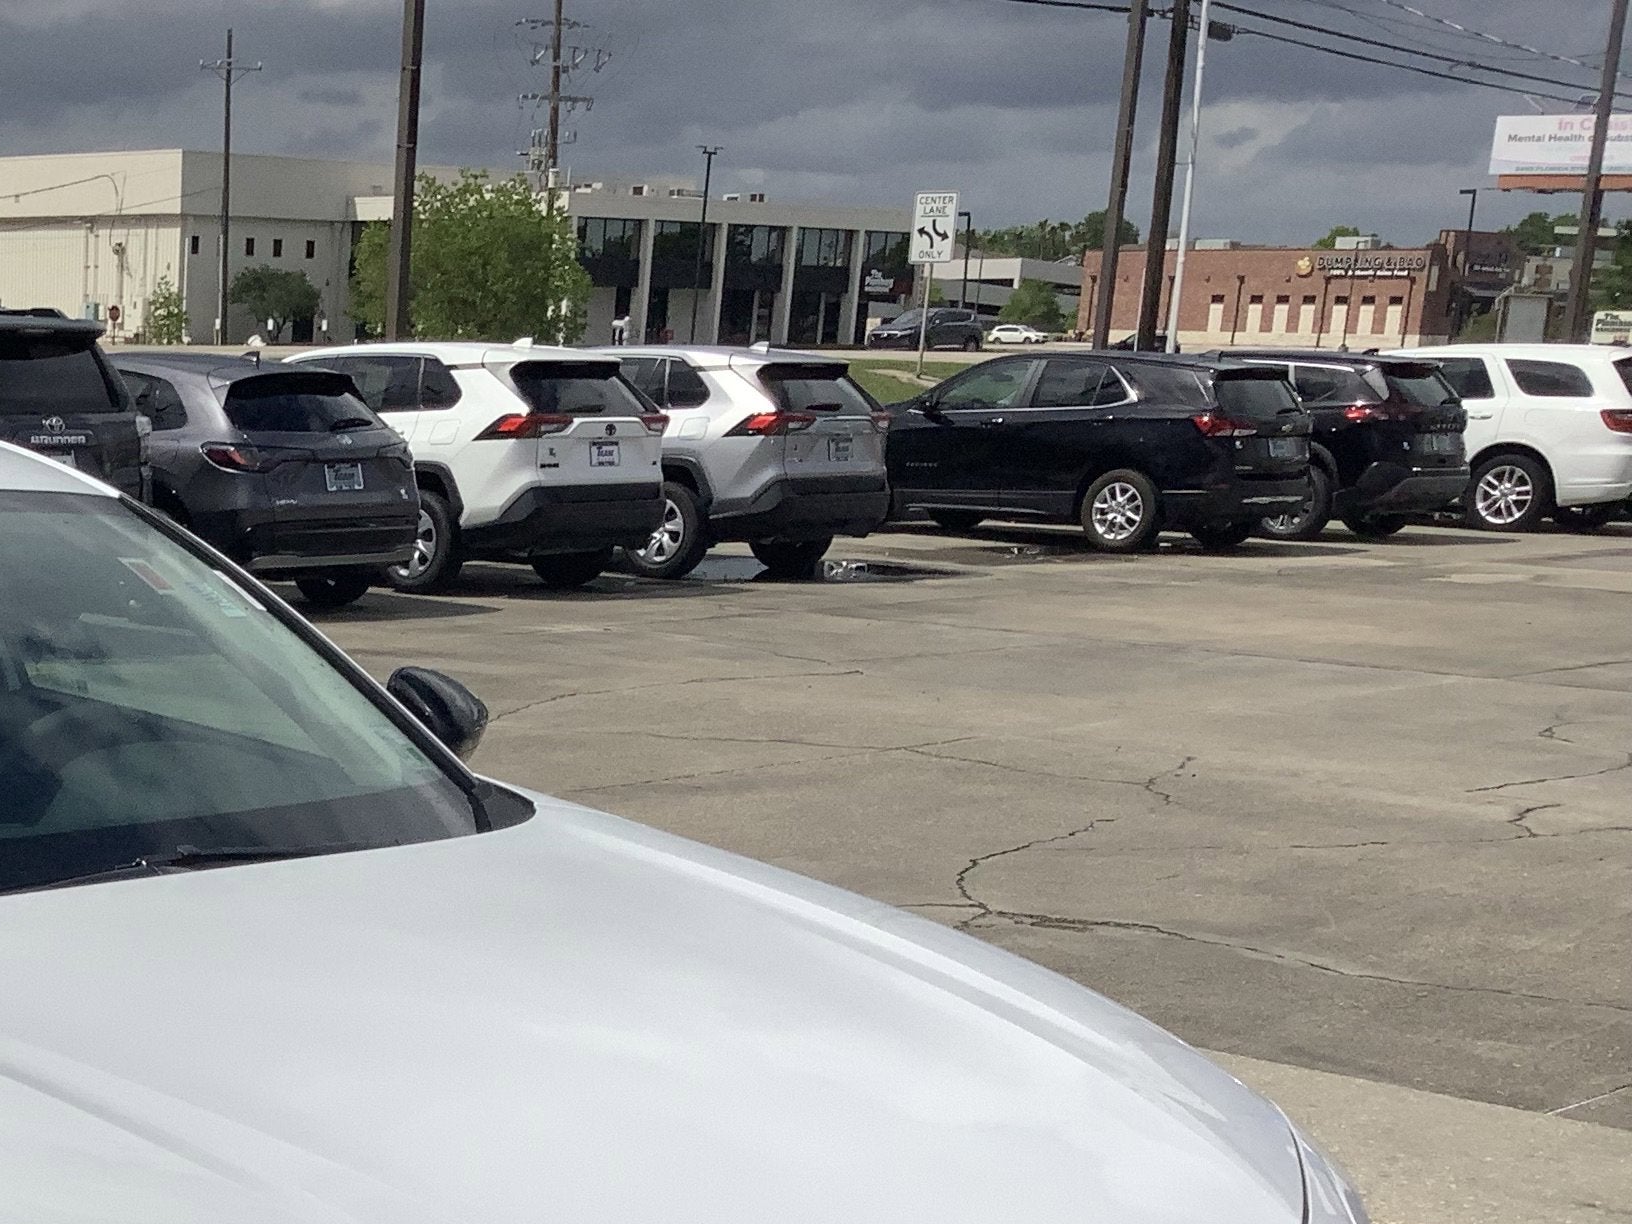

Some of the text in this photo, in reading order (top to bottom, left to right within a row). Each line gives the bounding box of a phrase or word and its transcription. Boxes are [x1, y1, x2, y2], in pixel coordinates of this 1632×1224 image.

[1507, 134, 1545, 143] Mental
[1548, 134, 1584, 143] Health
[919, 196, 954, 205] CENTER
[923, 206, 947, 214] LANE
[918, 250, 943, 259] ONLY
[1317, 255, 1384, 268] DUMPING
[1398, 256, 1425, 269] BAO
